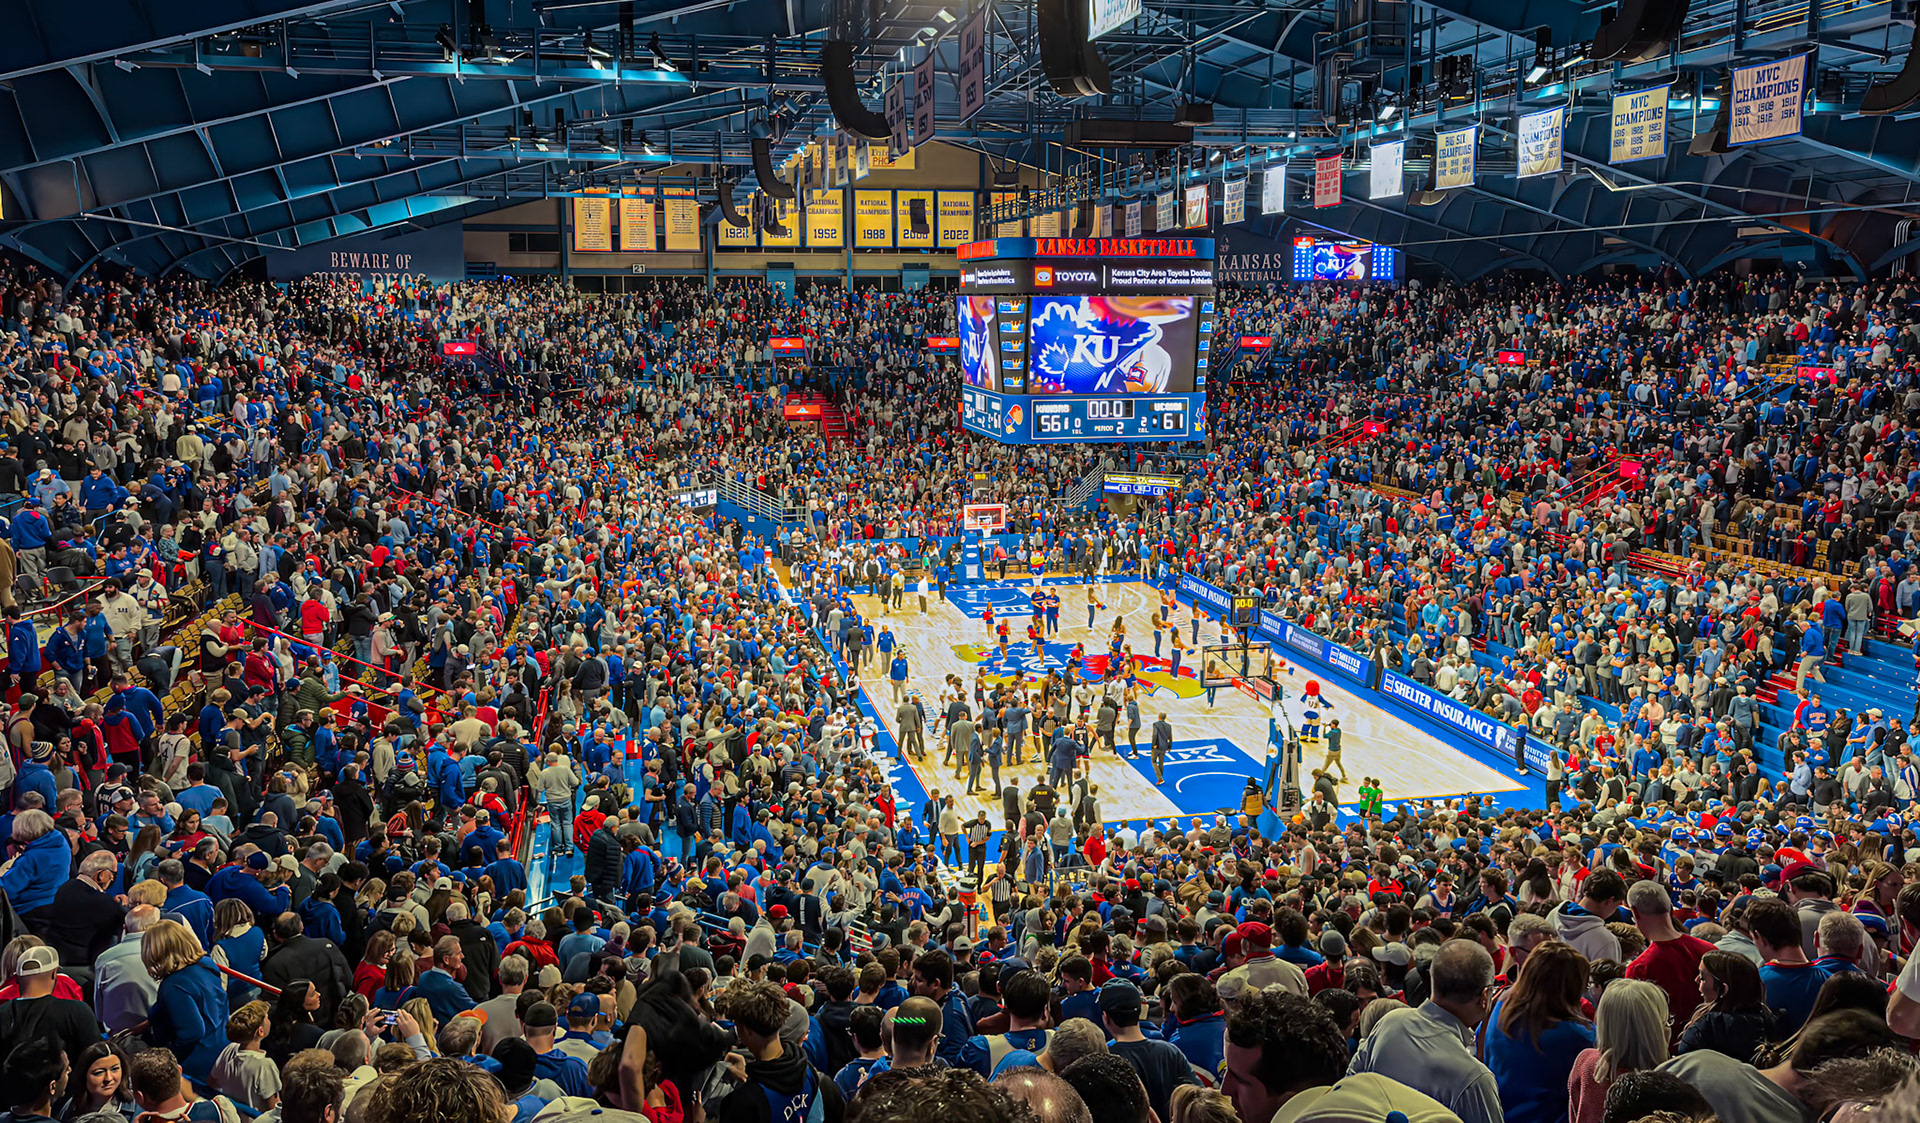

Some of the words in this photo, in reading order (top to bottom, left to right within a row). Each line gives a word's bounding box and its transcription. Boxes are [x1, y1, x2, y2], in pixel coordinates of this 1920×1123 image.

[1756, 66, 1780, 84] MVC
[1736, 78, 1798, 104] CHAMPIONS
[1630, 95, 1649, 110] MVC
[1615, 107, 1663, 126] CHAMPIONS
[1734, 117, 1749, 127] 1911
[1758, 113, 1773, 124] 1912
[1781, 108, 1795, 119] 1914
[814, 228, 837, 239] 1952
[863, 229, 885, 239] 1988
[943, 230, 968, 240] 2022
[1035, 238, 1096, 256] KANSAS
[1100, 239, 1196, 257] BASKETBALL
[331, 252, 389, 268] BEWARE
[396, 254, 411, 269] OF
[1219, 254, 1282, 270] KANSAS
[1327, 259, 1345, 270] KU
[1055, 272, 1097, 282] TOYOTA
[1137, 269, 1150, 278] City
[1151, 269, 1166, 277] Area
[1167, 269, 1189, 278] Toyota
[1218, 271, 1282, 282] BASKETBALL
[1071, 334, 1123, 368] KU
[1089, 401, 1123, 418] 00.0
[1041, 415, 1061, 432] 56
[1074, 418, 1081, 428] 0
[1116, 422, 1124, 434] 2
[1141, 417, 1147, 427] 2
[1164, 413, 1183, 429] 61
[1340, 652, 1361, 668] SHELTER
[1393, 680, 1431, 709] SHELTER
[1433, 699, 1494, 740] INSURANCE
